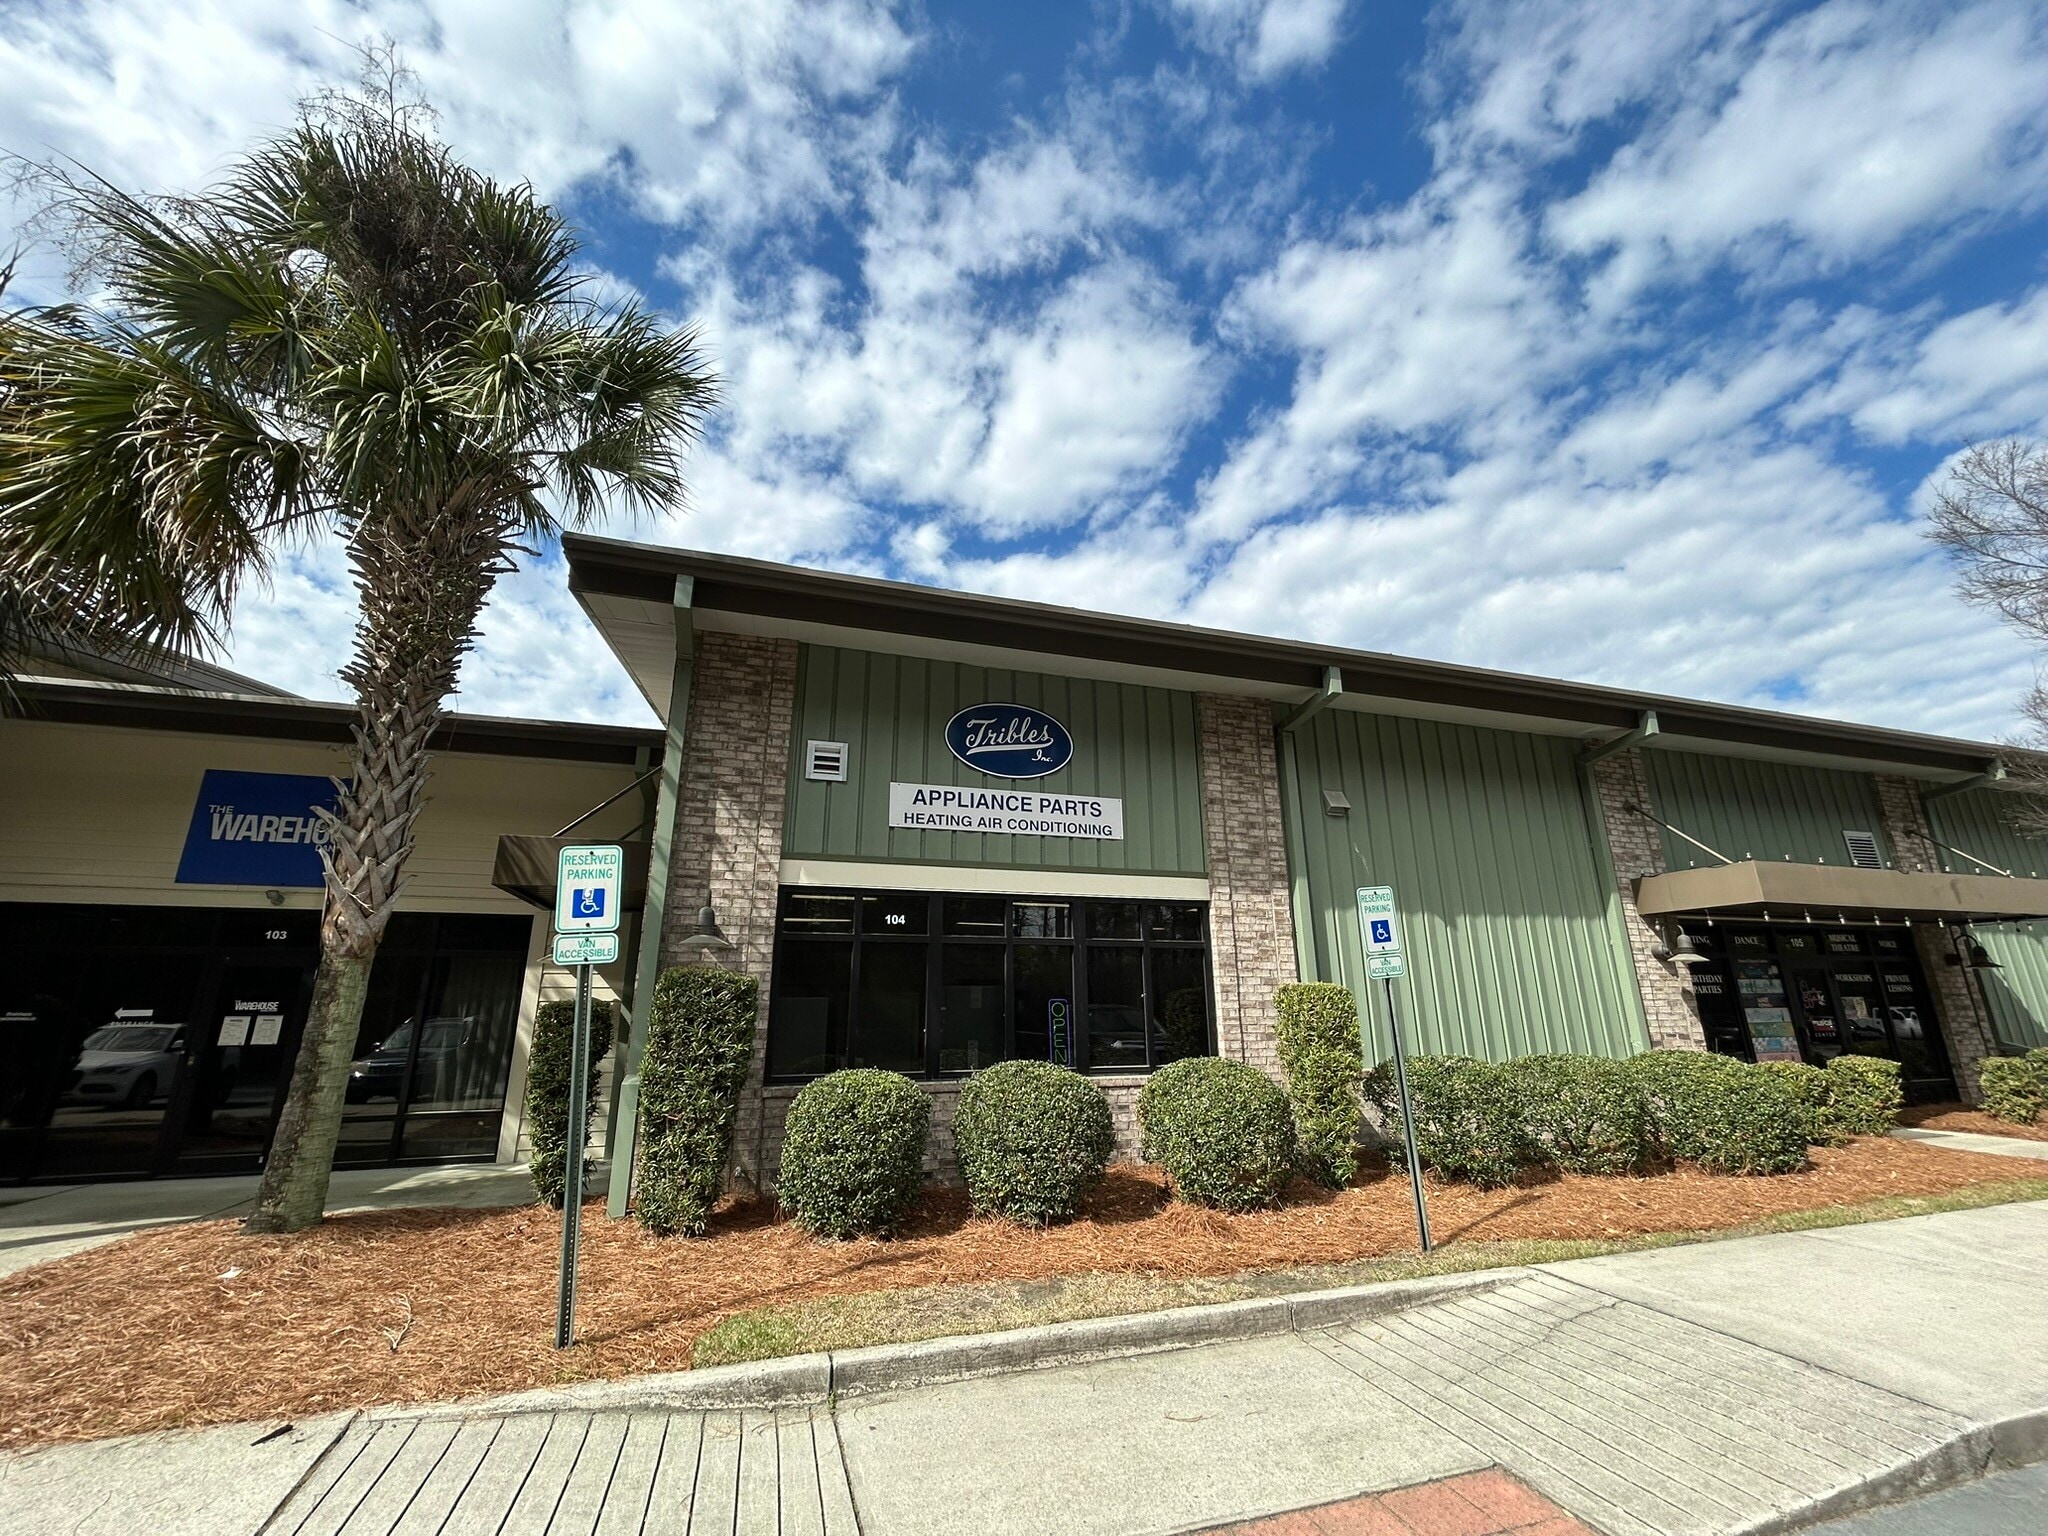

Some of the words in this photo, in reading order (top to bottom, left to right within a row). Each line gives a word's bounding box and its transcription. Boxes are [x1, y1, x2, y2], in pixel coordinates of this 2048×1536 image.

[966, 716, 1053, 750] Tribles
[1031, 749, 1053, 762] Inc.
[912, 789, 1033, 813] APPLIANCE
[1039, 798, 1102, 817] PARTS
[209, 804, 235, 814] THE
[211, 813, 330, 844] WAREHO
[904, 812, 972, 827] HEATING
[977, 817, 1003, 829] AIR
[1007, 818, 1113, 836] CONDITIONING
[565, 854, 617, 866] RESERVED
[567, 868, 613, 880] PARKING
[1361, 893, 1391, 903] RESERVED
[1364, 904, 1391, 914] PARKING
[885, 914, 906, 925] 104
[265, 930, 288, 940] 103
[1828, 934, 1857, 943] MUSICAL
[577, 941, 596, 949] VAN
[1734, 936, 1760, 945] DANCE
[1790, 938, 1804, 948] 105
[1830, 943, 1860, 952] THEATRE
[558, 948, 612, 959] ACCESSIBLE
[1380, 959, 1391, 967] VAN
[1372, 966, 1403, 975] ACCESSIBLE
[1692, 974, 1723, 983] RTHDAY
[1884, 974, 1912, 983] PRIVATE
[1694, 984, 1722, 994] PARTIES
[1887, 984, 1915, 993] LESSONS
[234, 1001, 280, 1011] WAREHOUSE
[1051, 1001, 1067, 1063] OPEN
